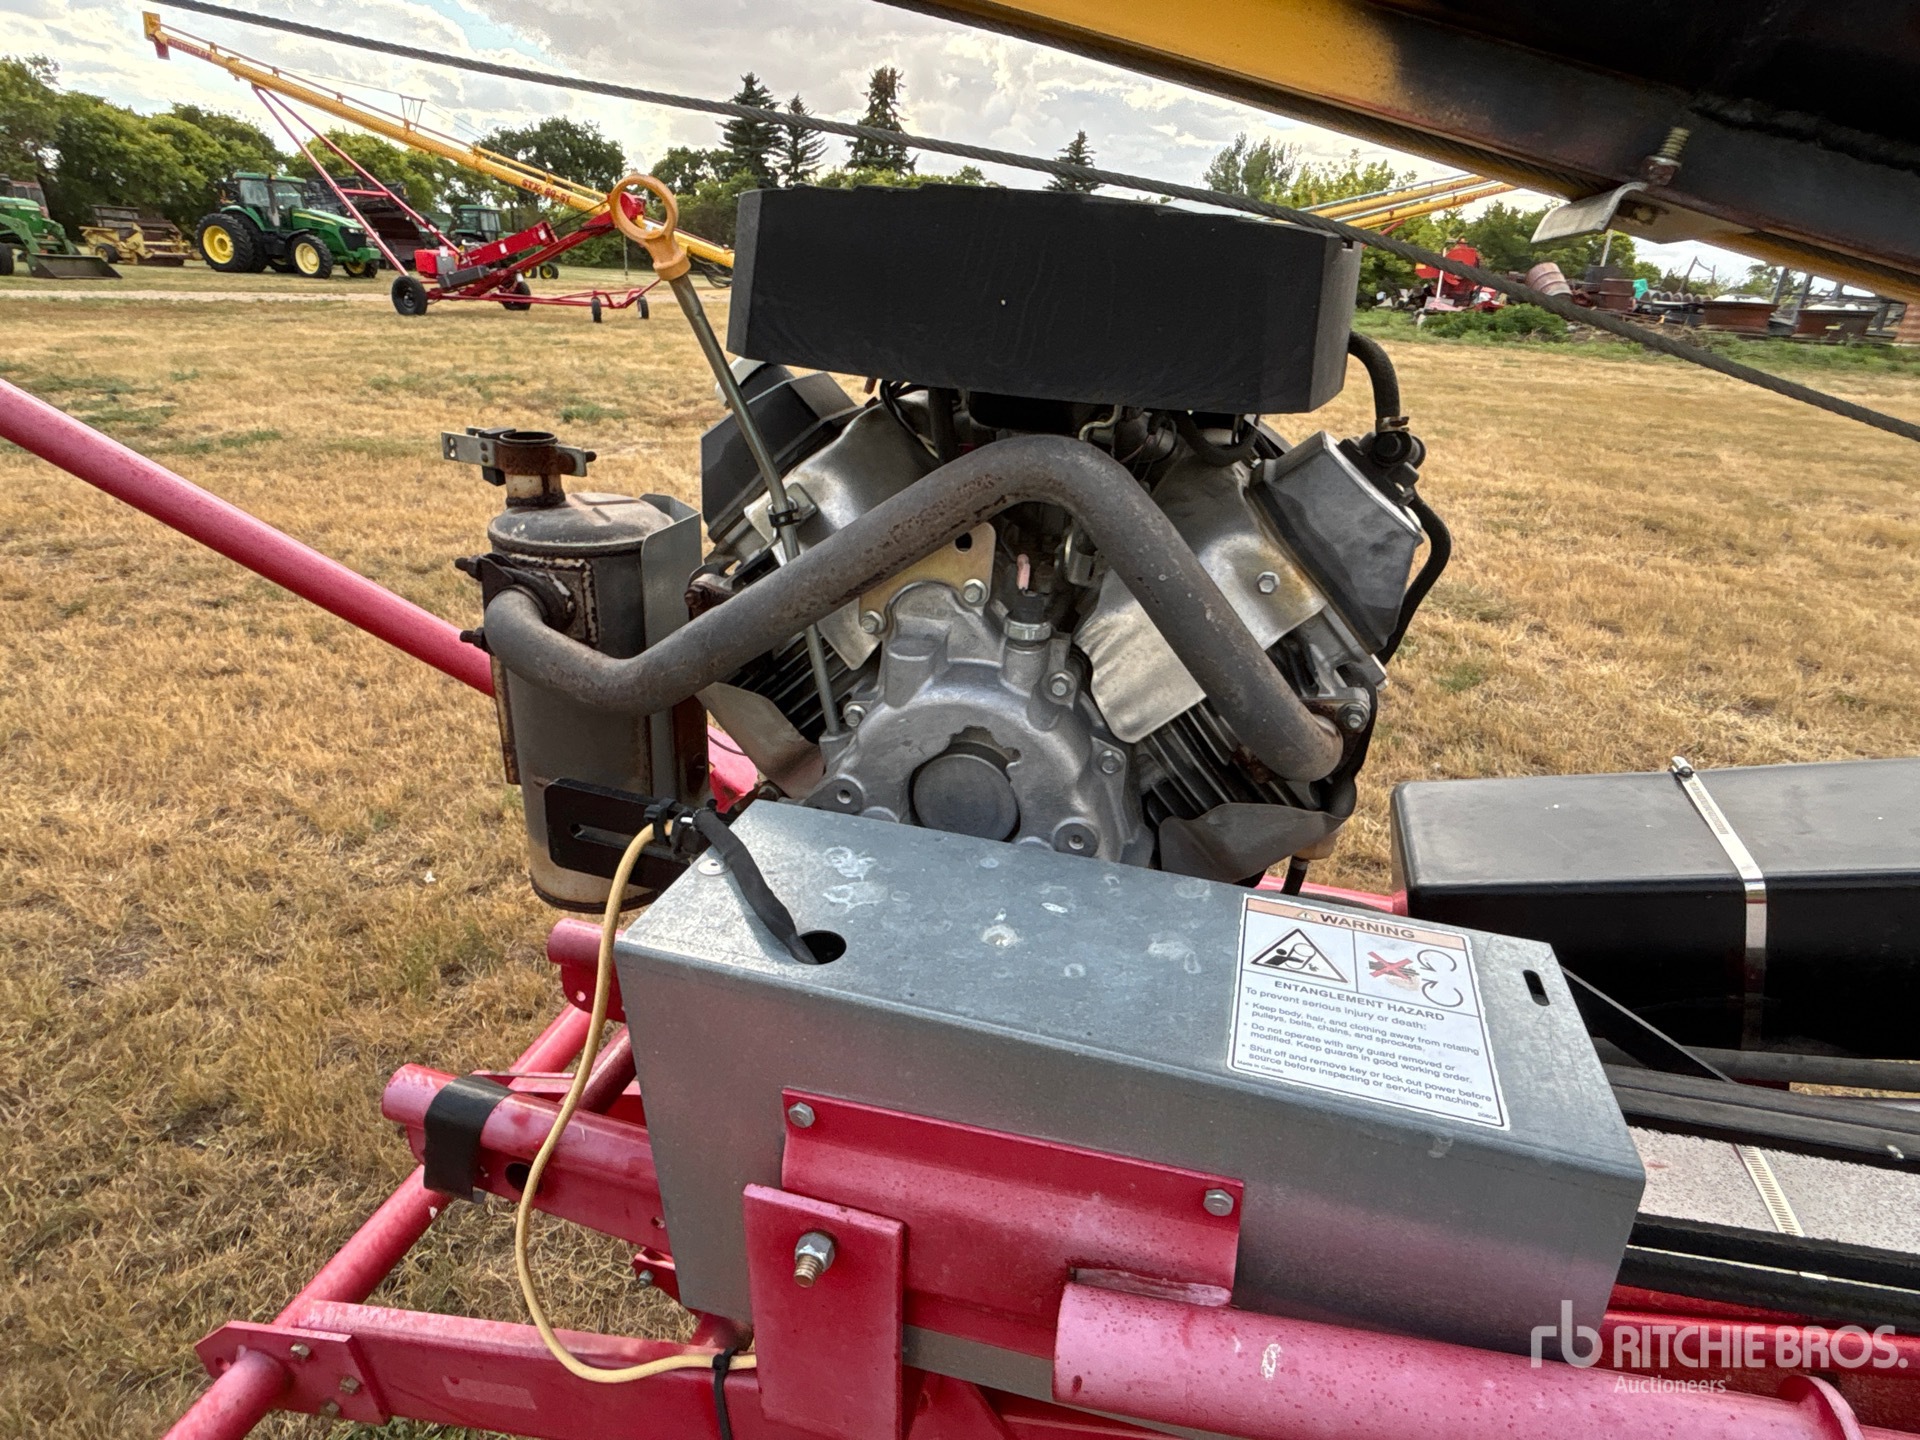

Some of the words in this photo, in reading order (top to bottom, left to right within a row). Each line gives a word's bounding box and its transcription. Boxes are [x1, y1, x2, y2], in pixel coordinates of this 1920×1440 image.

[1320, 913, 1415, 939] WARNING
[1245, 987, 1257, 995] To
[1260, 991, 1300, 1004] prevent
[1302, 1000, 1341, 1013] serious
[1345, 1007, 1374, 1020] injury
[1392, 1018, 1427, 1030] death:
[1274, 981, 1384, 1009] ENTANGLEMENT
[1387, 1003, 1445, 1021] HAZARD
[1251, 1010, 1287, 1023] pulleys,
[1290, 1017, 1315, 1029] belts,
[1317, 1024, 1351, 1037] chains,
[1354, 1032, 1373, 1041] and
[1375, 1036, 1426, 1052] sprockets.
[1251, 1023, 1265, 1031] Do
[1267, 1026, 1282, 1035] not
[1284, 1031, 1322, 1043] operate
[1323, 1038, 1344, 1048] with
[1346, 1043, 1364, 1053] any
[1366, 1048, 1396, 1059] guard
[1398, 1054, 1442, 1069] removed
[1252, 1003, 1277, 1013] Keep
[1306, 1013, 1326, 1024] hair,
[1329, 1018, 1347, 1027] and
[1350, 1023, 1387, 1037] clothing
[1390, 1032, 1415, 1042] away
[1418, 1036, 1440, 1047] from
[1443, 1042, 1480, 1056] rotating
[1249, 1044, 1272, 1055] Shut
[1274, 1050, 1286, 1058] off
[1288, 1053, 1307, 1062] and
[1309, 1058, 1347, 1070] remove
[1349, 1065, 1367, 1076] key
[1382, 1072, 1403, 1083] lock
[1405, 1078, 1422, 1087] out
[1424, 1082, 1456, 1095] power
[1458, 1088, 1492, 1102] before
[1250, 1031, 1293, 1046] modified.
[1296, 1040, 1322, 1052] Keep
[1324, 1047, 1359, 1059] guards
[1361, 1054, 1370, 1062] in
[1372, 1058, 1398, 1068] good
[1400, 1063, 1440, 1078] working
[1442, 1072, 1473, 1084] order.
[1249, 1053, 1282, 1065] source
[1284, 1060, 1316, 1072] before
[1319, 1067, 1370, 1086] inspecting
[1386, 1083, 1432, 1099] servicing
[1435, 1094, 1483, 1109] machine.
